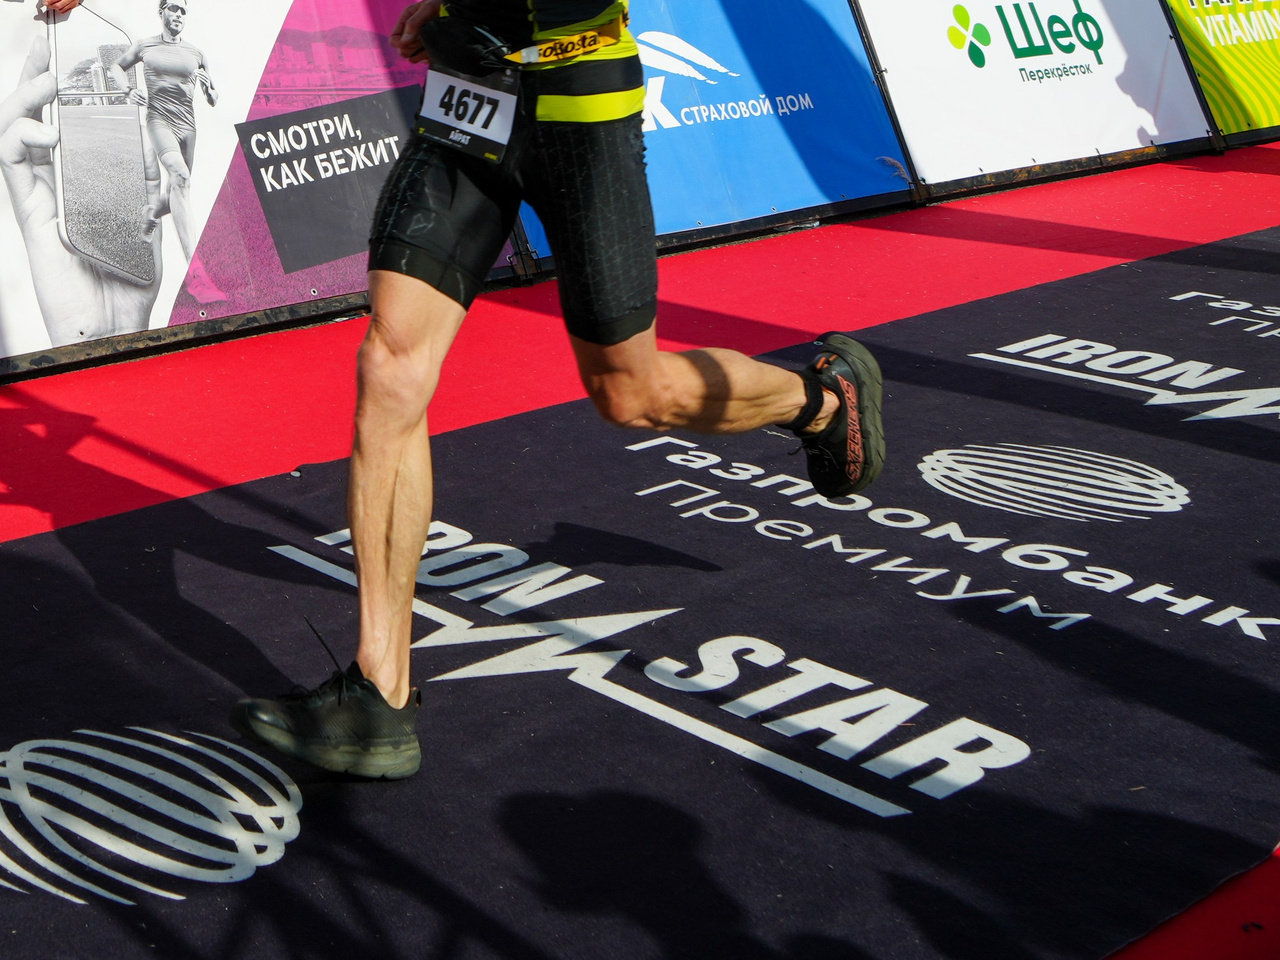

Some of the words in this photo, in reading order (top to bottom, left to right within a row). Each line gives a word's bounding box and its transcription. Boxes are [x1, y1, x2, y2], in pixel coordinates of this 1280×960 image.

[1019, 63, 1093, 84] Перекрёсток
[439, 84, 500, 130] 4677
[681, 94, 774, 126] СТРАХОВОЙ
[775, 92, 814, 117] ДОМ
[250, 113, 362, 159] СМОТРИ,
[259, 157, 315, 193] КАК
[314, 135, 401, 179] БЕЖИТ
[996, 333, 1246, 389] IRON
[837, 374, 865, 485] SKECHERS
[625, 435, 1280, 641] Газпромбанк
[635, 479, 1092, 631] Премиум
[644, 635, 1031, 800] STAR
